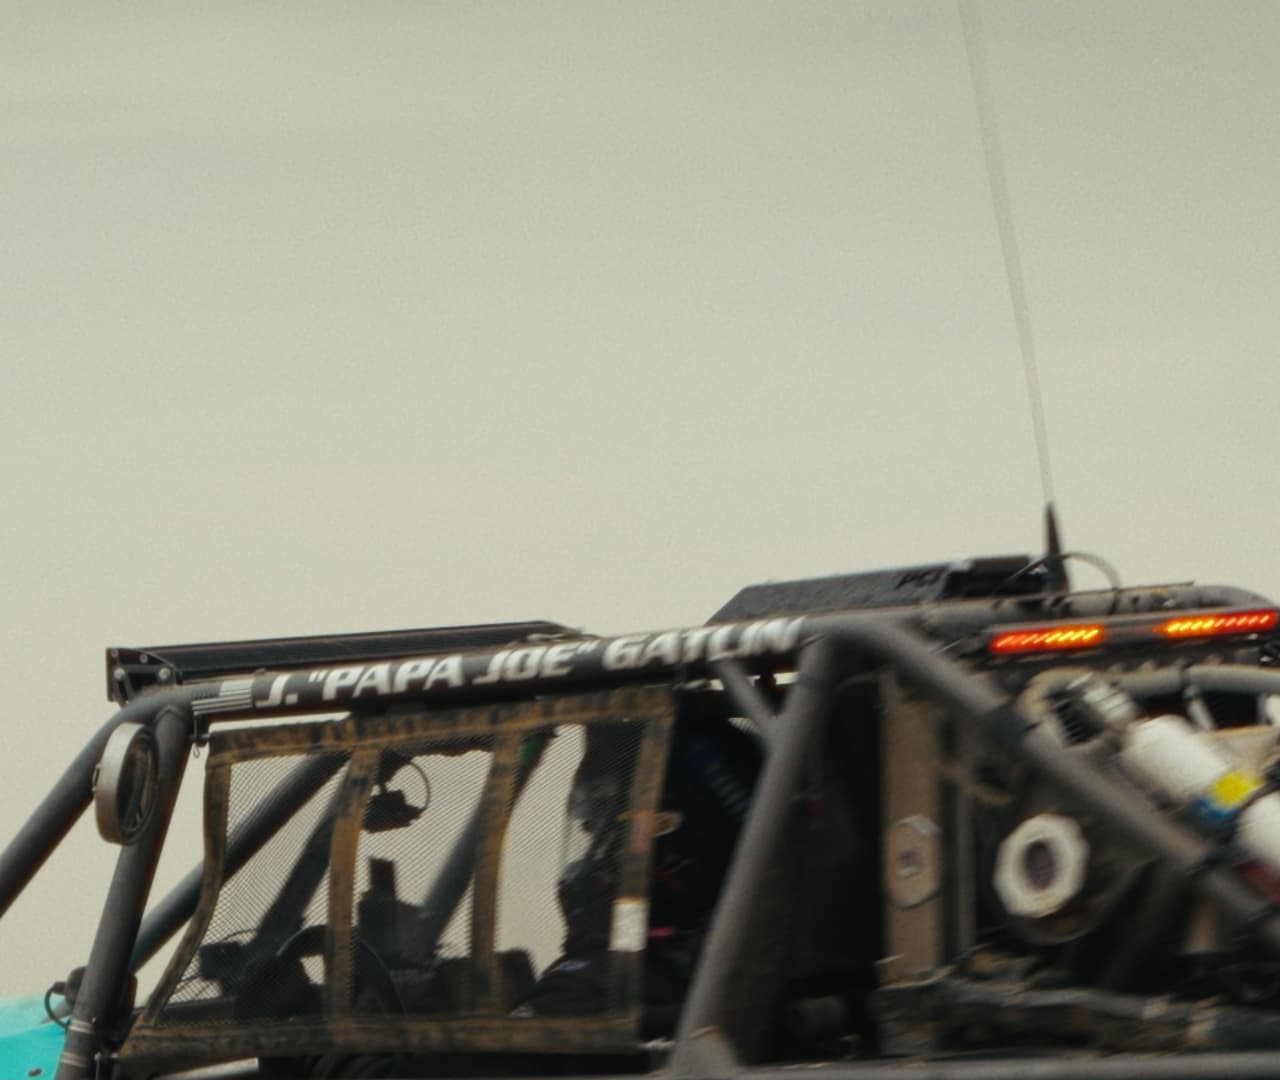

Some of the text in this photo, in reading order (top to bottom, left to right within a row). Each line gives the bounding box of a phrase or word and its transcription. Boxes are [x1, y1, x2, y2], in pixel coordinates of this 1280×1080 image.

[255, 615, 808, 708] J. "PAPA JOE" GATLIN
